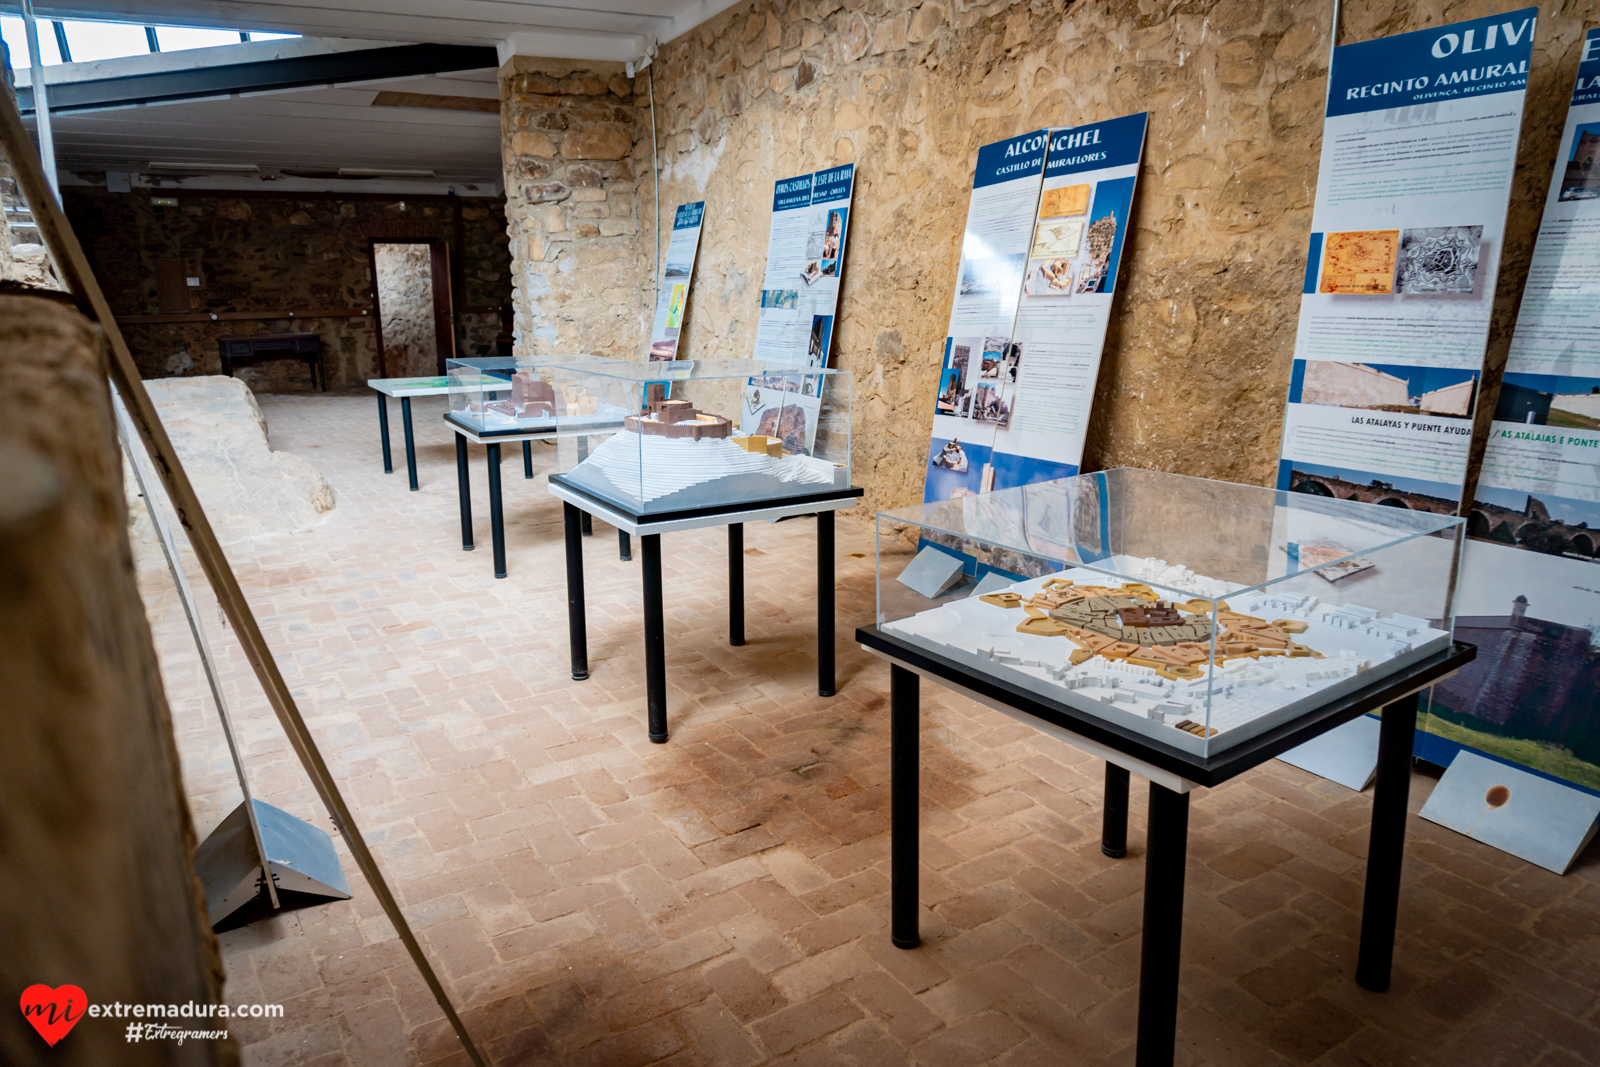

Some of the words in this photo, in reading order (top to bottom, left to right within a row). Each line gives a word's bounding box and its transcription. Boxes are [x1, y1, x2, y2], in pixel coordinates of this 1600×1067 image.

[1346, 76, 1429, 100] RECINTO
[1434, 60, 1529, 87] AMURAL
[1463, 80, 1507, 93] RECINTO
[1004, 128, 1102, 159] ALCONCHEL
[995, 160, 1031, 176] CASTILLO
[1031, 157, 1043, 168] DE
[1046, 150, 1107, 169] MIRAFLORES
[1351, 416, 1364, 425] LAS
[1365, 417, 1402, 429] ATALAYAS
[1404, 421, 1410, 429] Y
[1411, 422, 1442, 433] PUENTE
[1443, 426, 1471, 436] AYUDA
[1501, 430, 1512, 438] AS
[1514, 431, 1557, 443] ATALAIAS
[1559, 436, 1565, 444] E
[1567, 437, 1599, 448] PONTE
